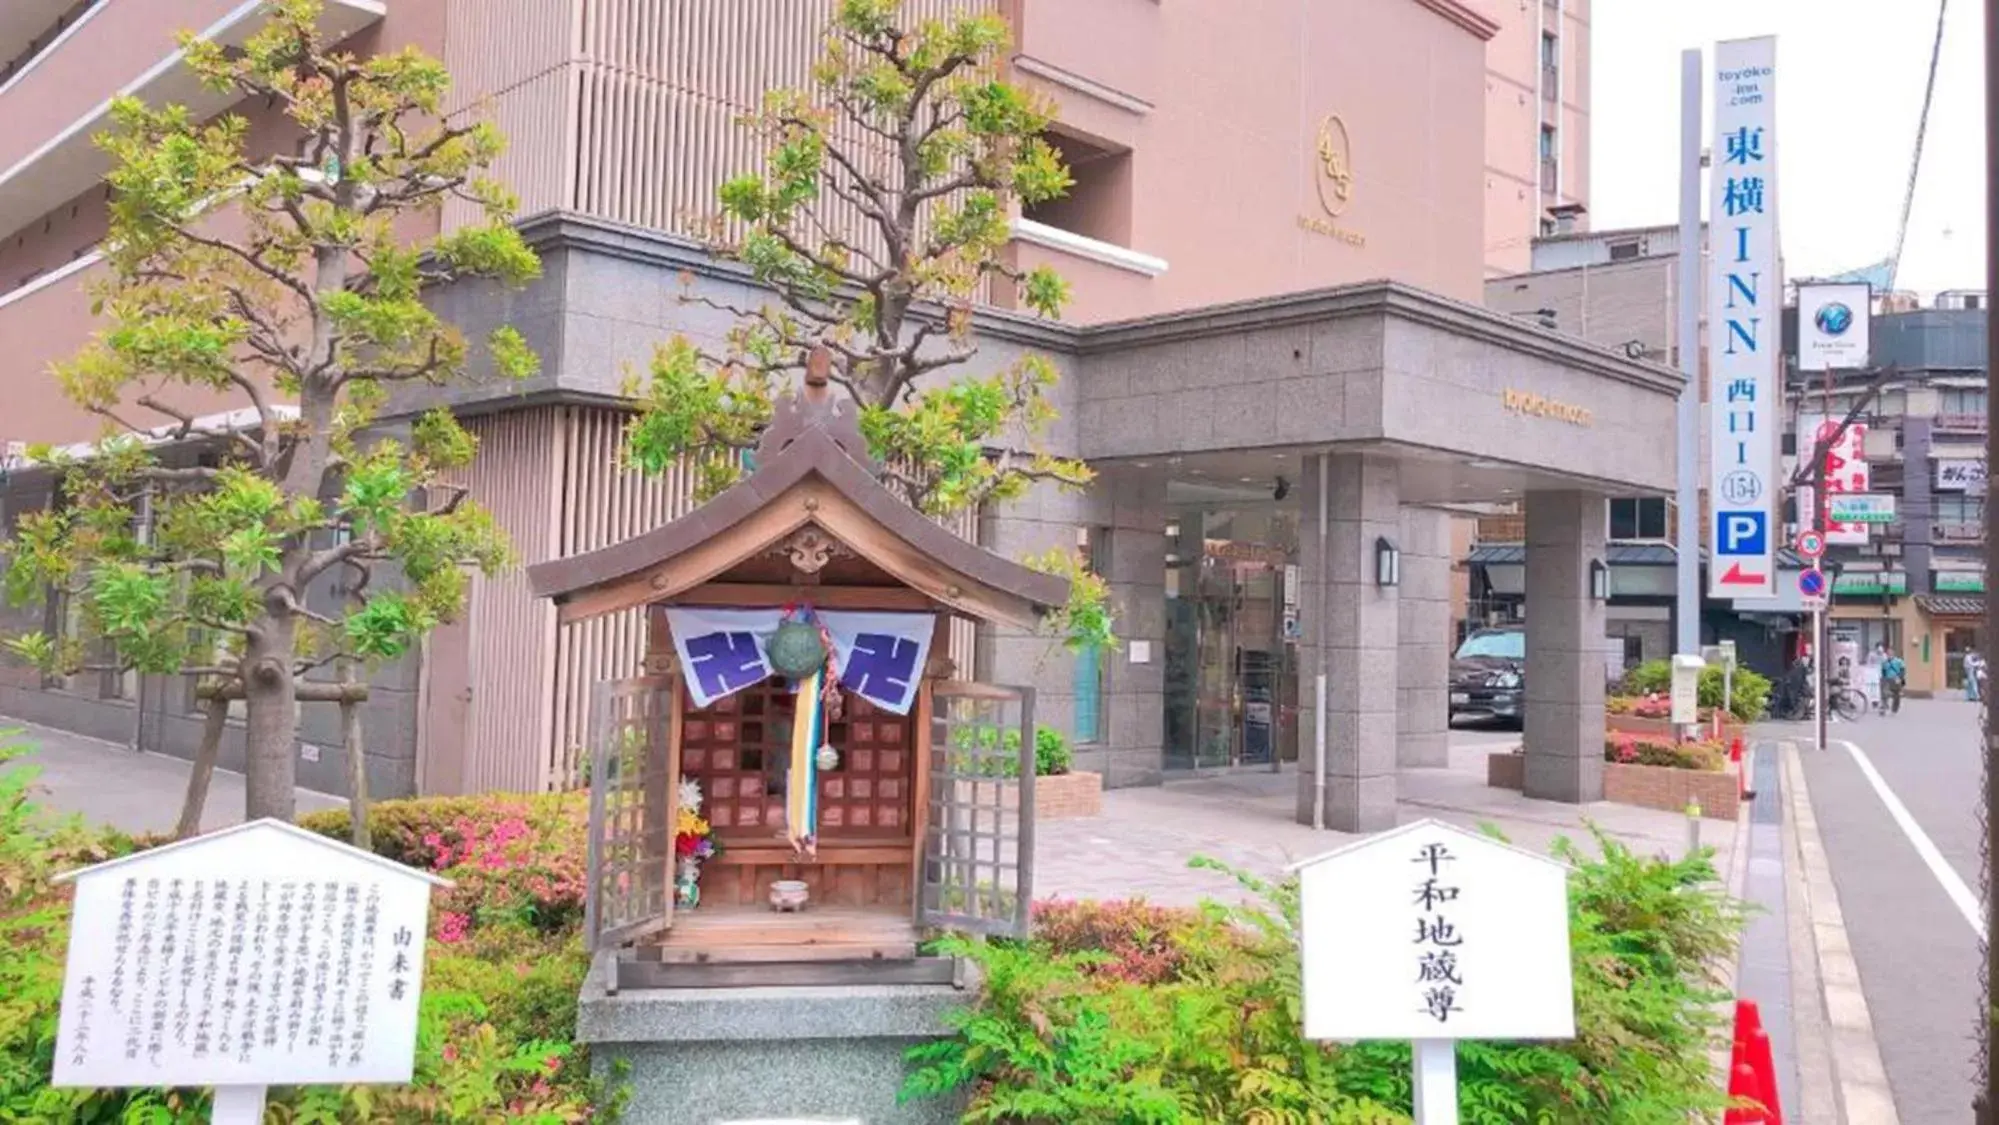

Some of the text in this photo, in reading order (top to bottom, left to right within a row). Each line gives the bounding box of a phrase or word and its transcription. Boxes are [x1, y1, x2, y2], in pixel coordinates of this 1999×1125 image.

[1718, 66, 1772, 81] toyoko
[1721, 126, 1765, 354] 東横INN
[1729, 475, 1757, 499] 154
[1727, 516, 1757, 550] P
[1411, 842, 1464, 1023] 平和地蔵尊
[388, 925, 412, 1000] 由来書
